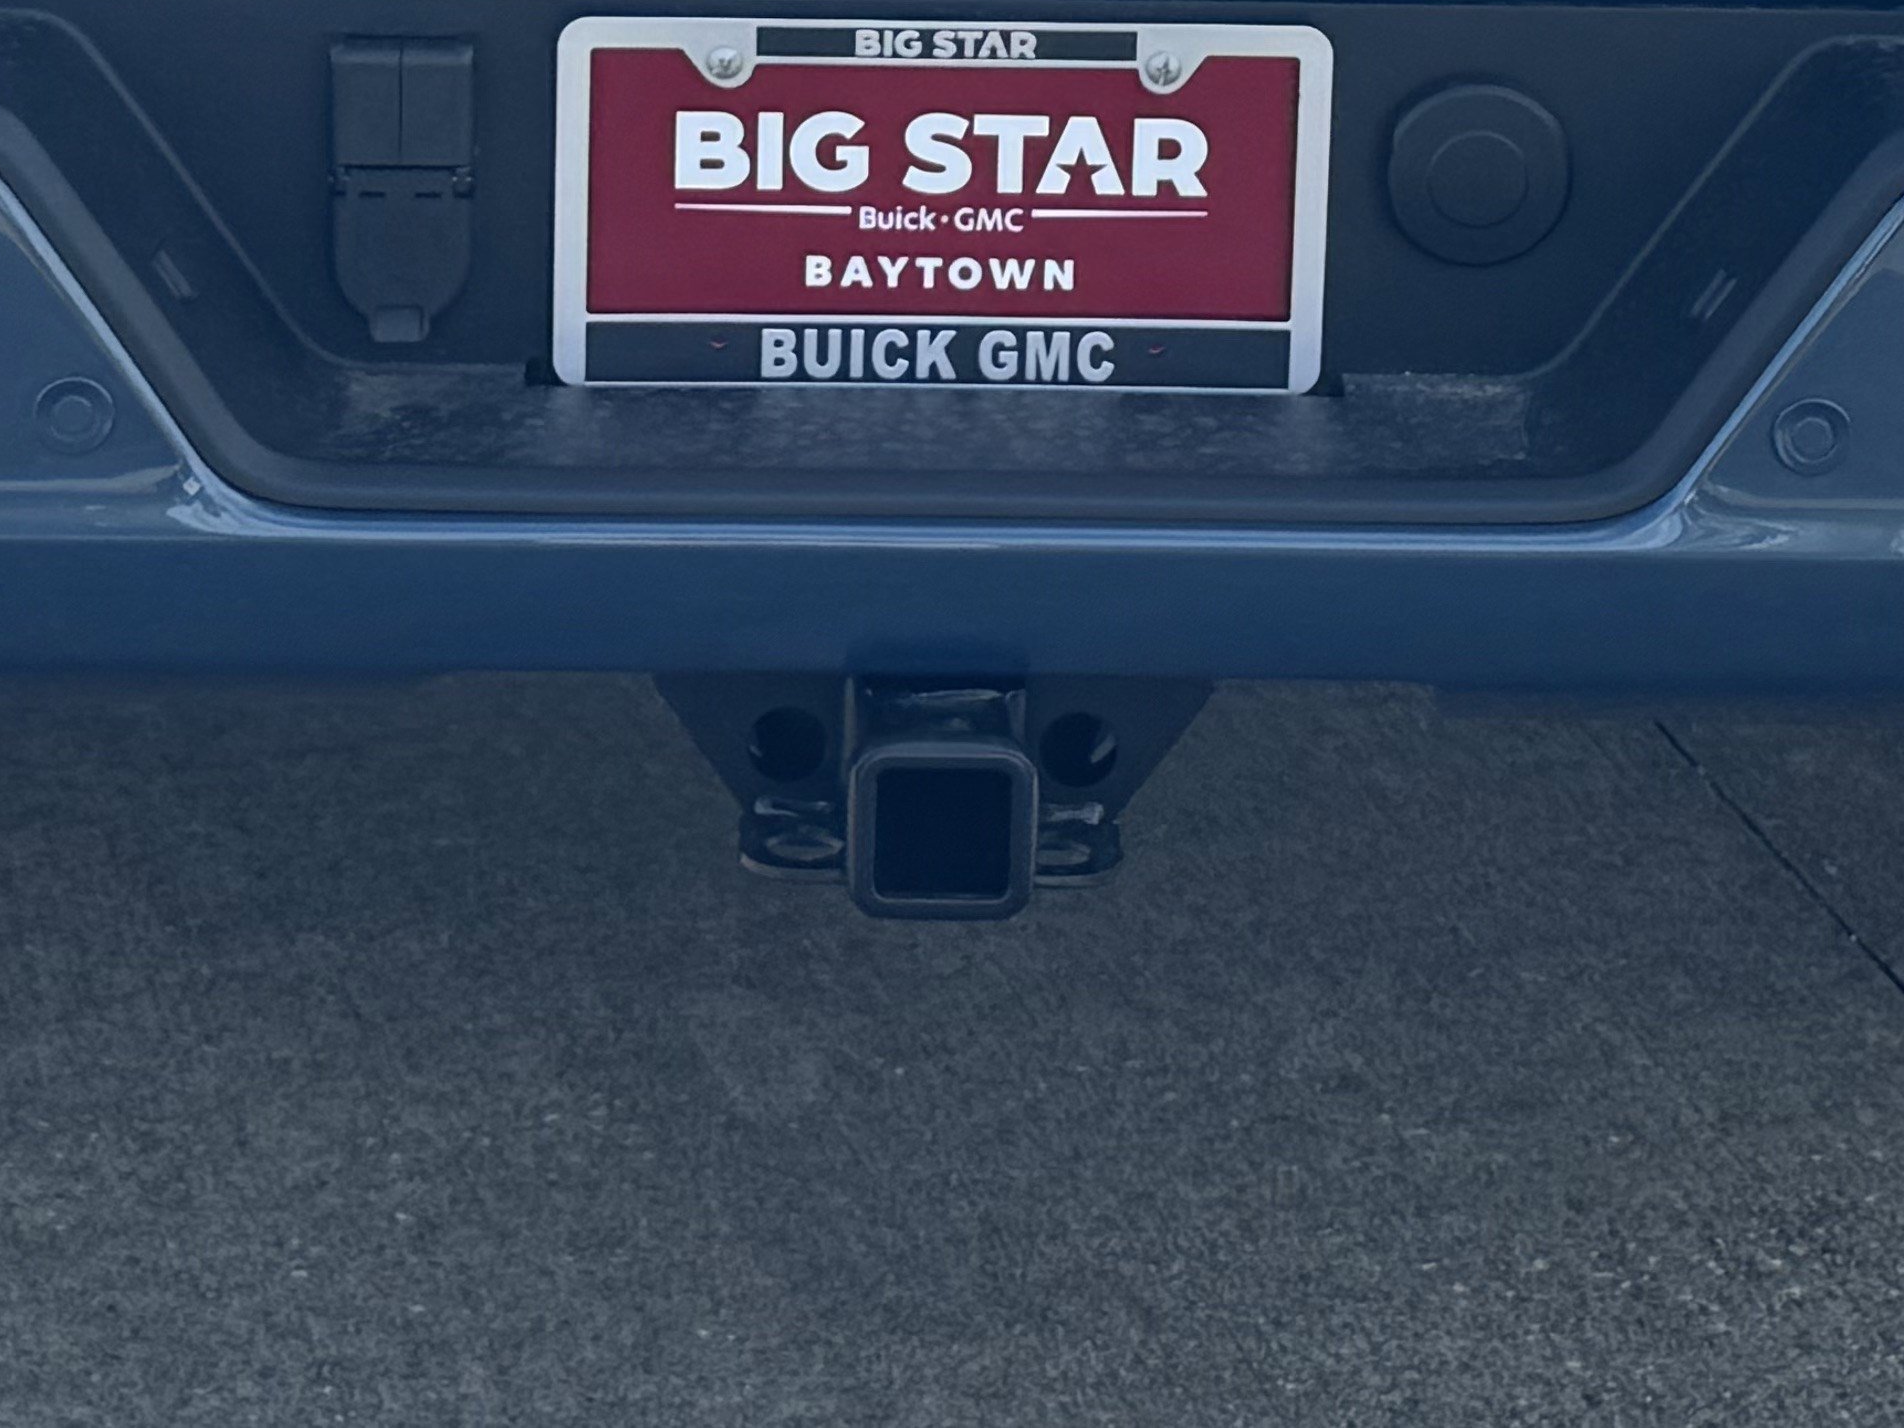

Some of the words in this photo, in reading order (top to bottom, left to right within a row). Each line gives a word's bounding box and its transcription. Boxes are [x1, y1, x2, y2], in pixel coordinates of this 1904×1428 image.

[854, 29, 922, 57] BIG
[932, 30, 1036, 59] STAR
[674, 110, 870, 192] BIG
[902, 112, 1208, 197] STAR
[858, 205, 936, 231] Buick
[953, 207, 1025, 233] GMC
[804, 255, 1075, 290] BAYTOWN
[760, 328, 957, 380] BUICK
[977, 330, 1115, 381] GMC
